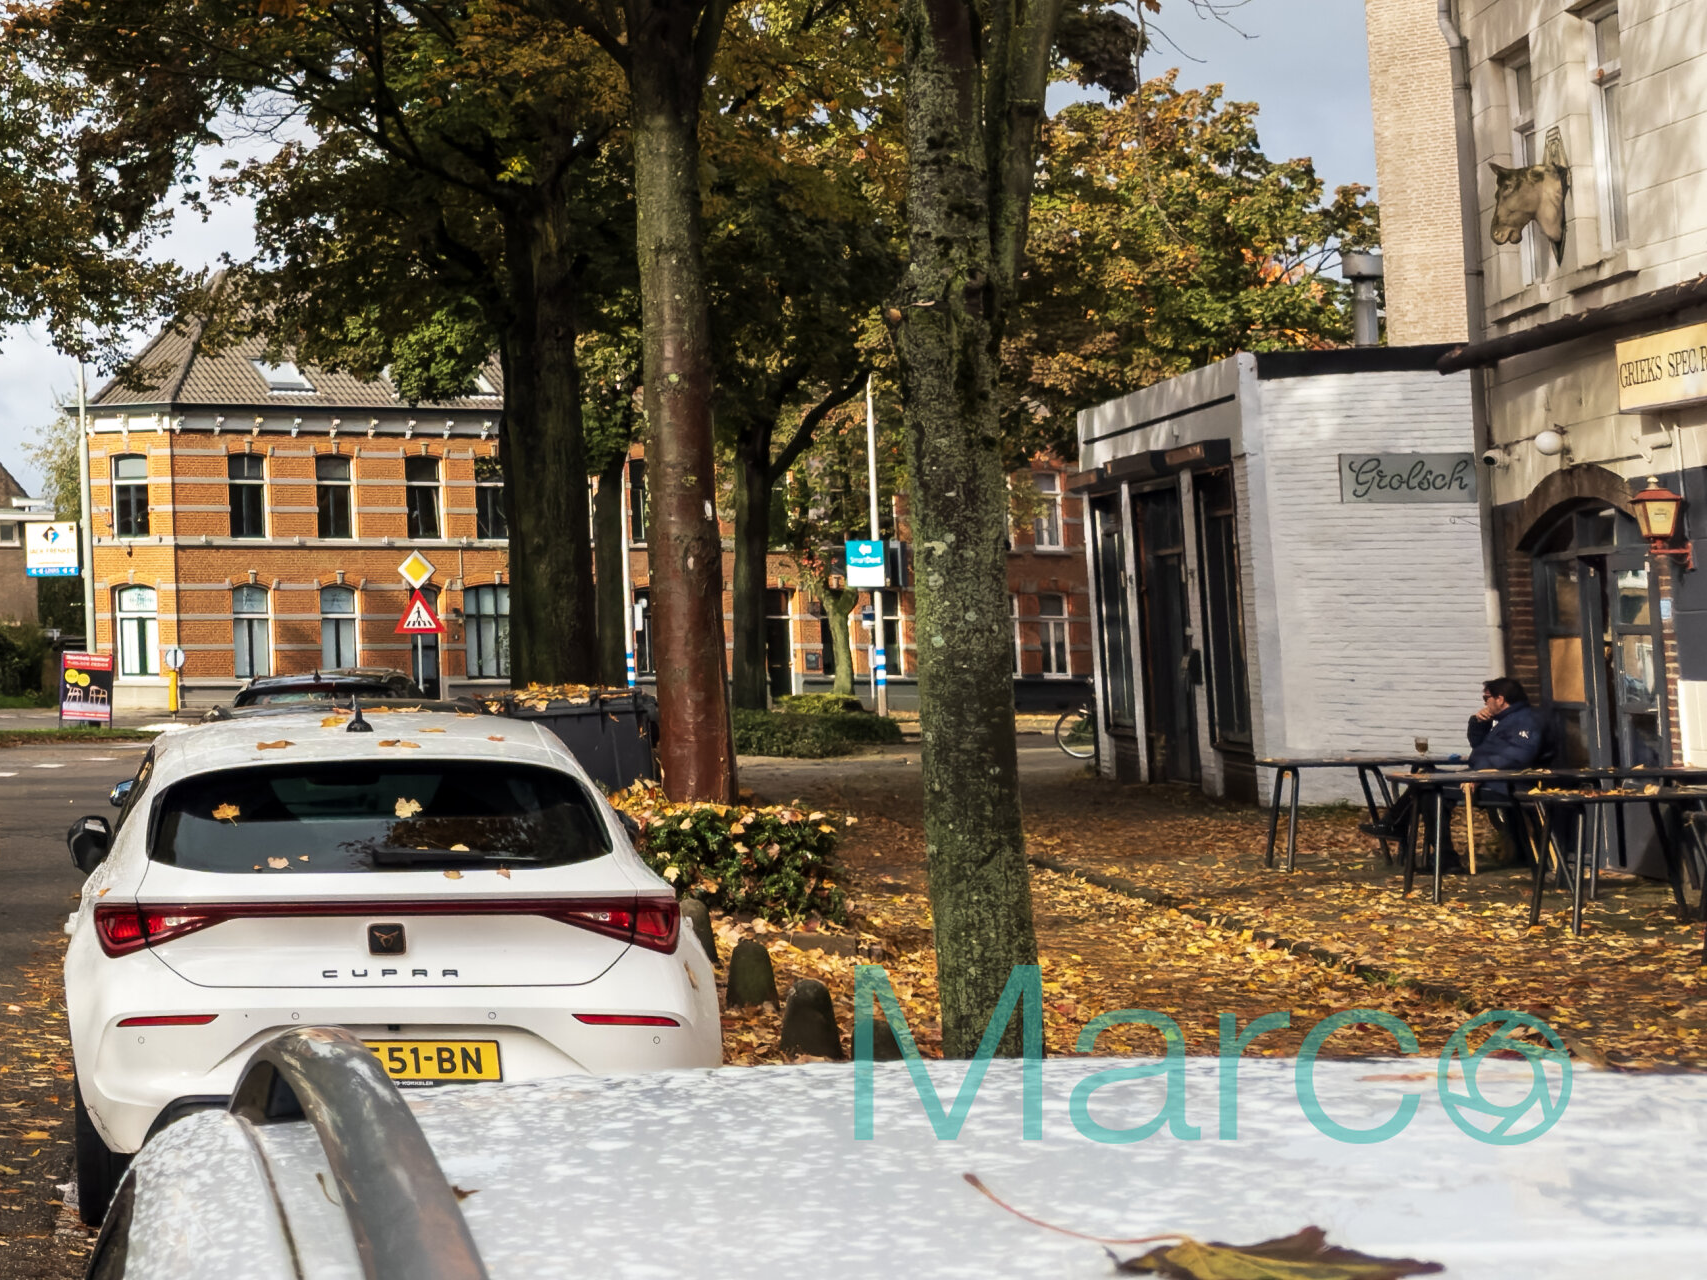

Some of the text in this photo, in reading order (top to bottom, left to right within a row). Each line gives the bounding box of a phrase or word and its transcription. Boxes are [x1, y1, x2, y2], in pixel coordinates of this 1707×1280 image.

[1619, 355, 1663, 388] GRIEKS
[1667, 348, 1699, 378] SPEC.
[1348, 458, 1469, 498] Grolsch
[322, 969, 459, 978] CUPRA
[369, 1046, 484, 1075] 51-BN
